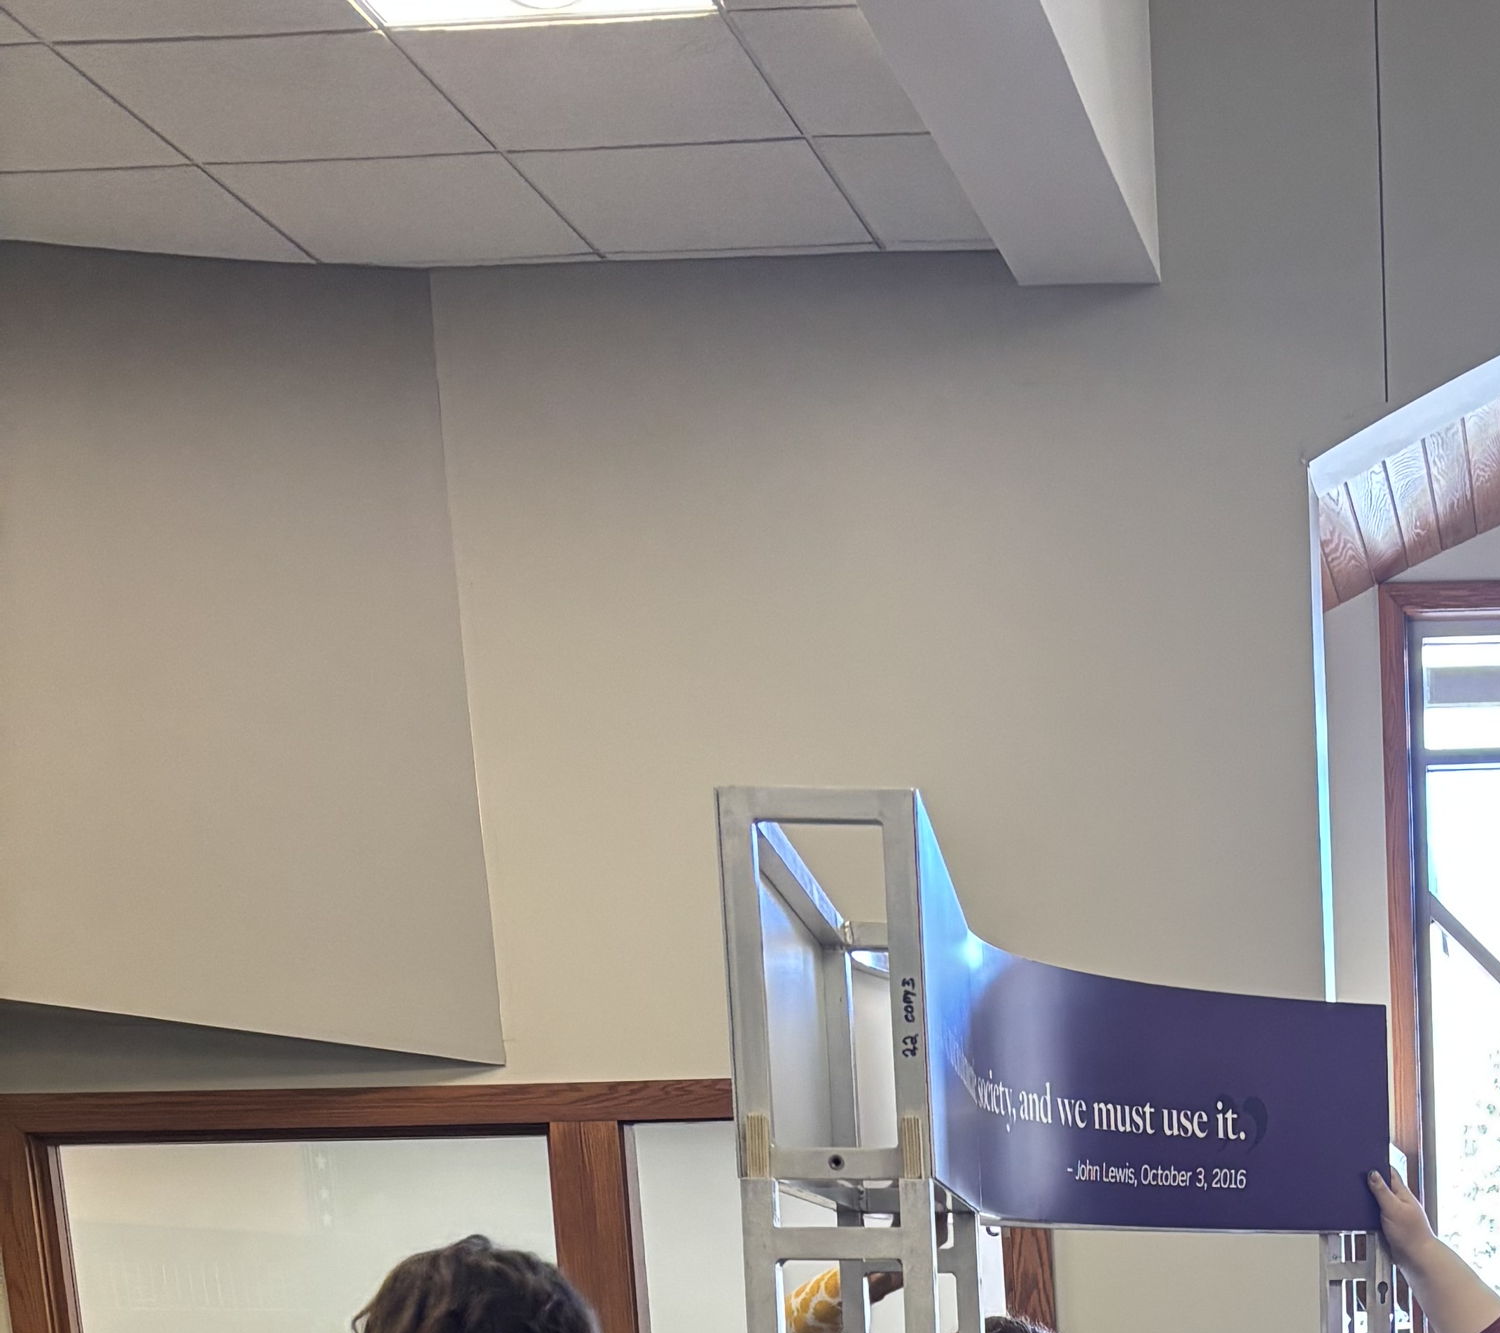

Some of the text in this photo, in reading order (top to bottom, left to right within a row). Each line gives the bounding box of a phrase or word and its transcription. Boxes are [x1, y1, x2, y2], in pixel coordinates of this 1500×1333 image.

[902, 1033, 919, 1058] 22
[1018, 1081, 1053, 1125] and
[1056, 1096, 1088, 1129] we
[1092, 1100, 1156, 1135] must
[1162, 1107, 1209, 1140] use
[1215, 1100, 1247, 1141] it.
[1075, 1159, 1101, 1182] John
[1102, 1162, 1138, 1187] Lewis,
[1140, 1163, 1193, 1188] October
[1195, 1167, 1209, 1191] 3,
[1211, 1168, 1247, 1190] 2016
